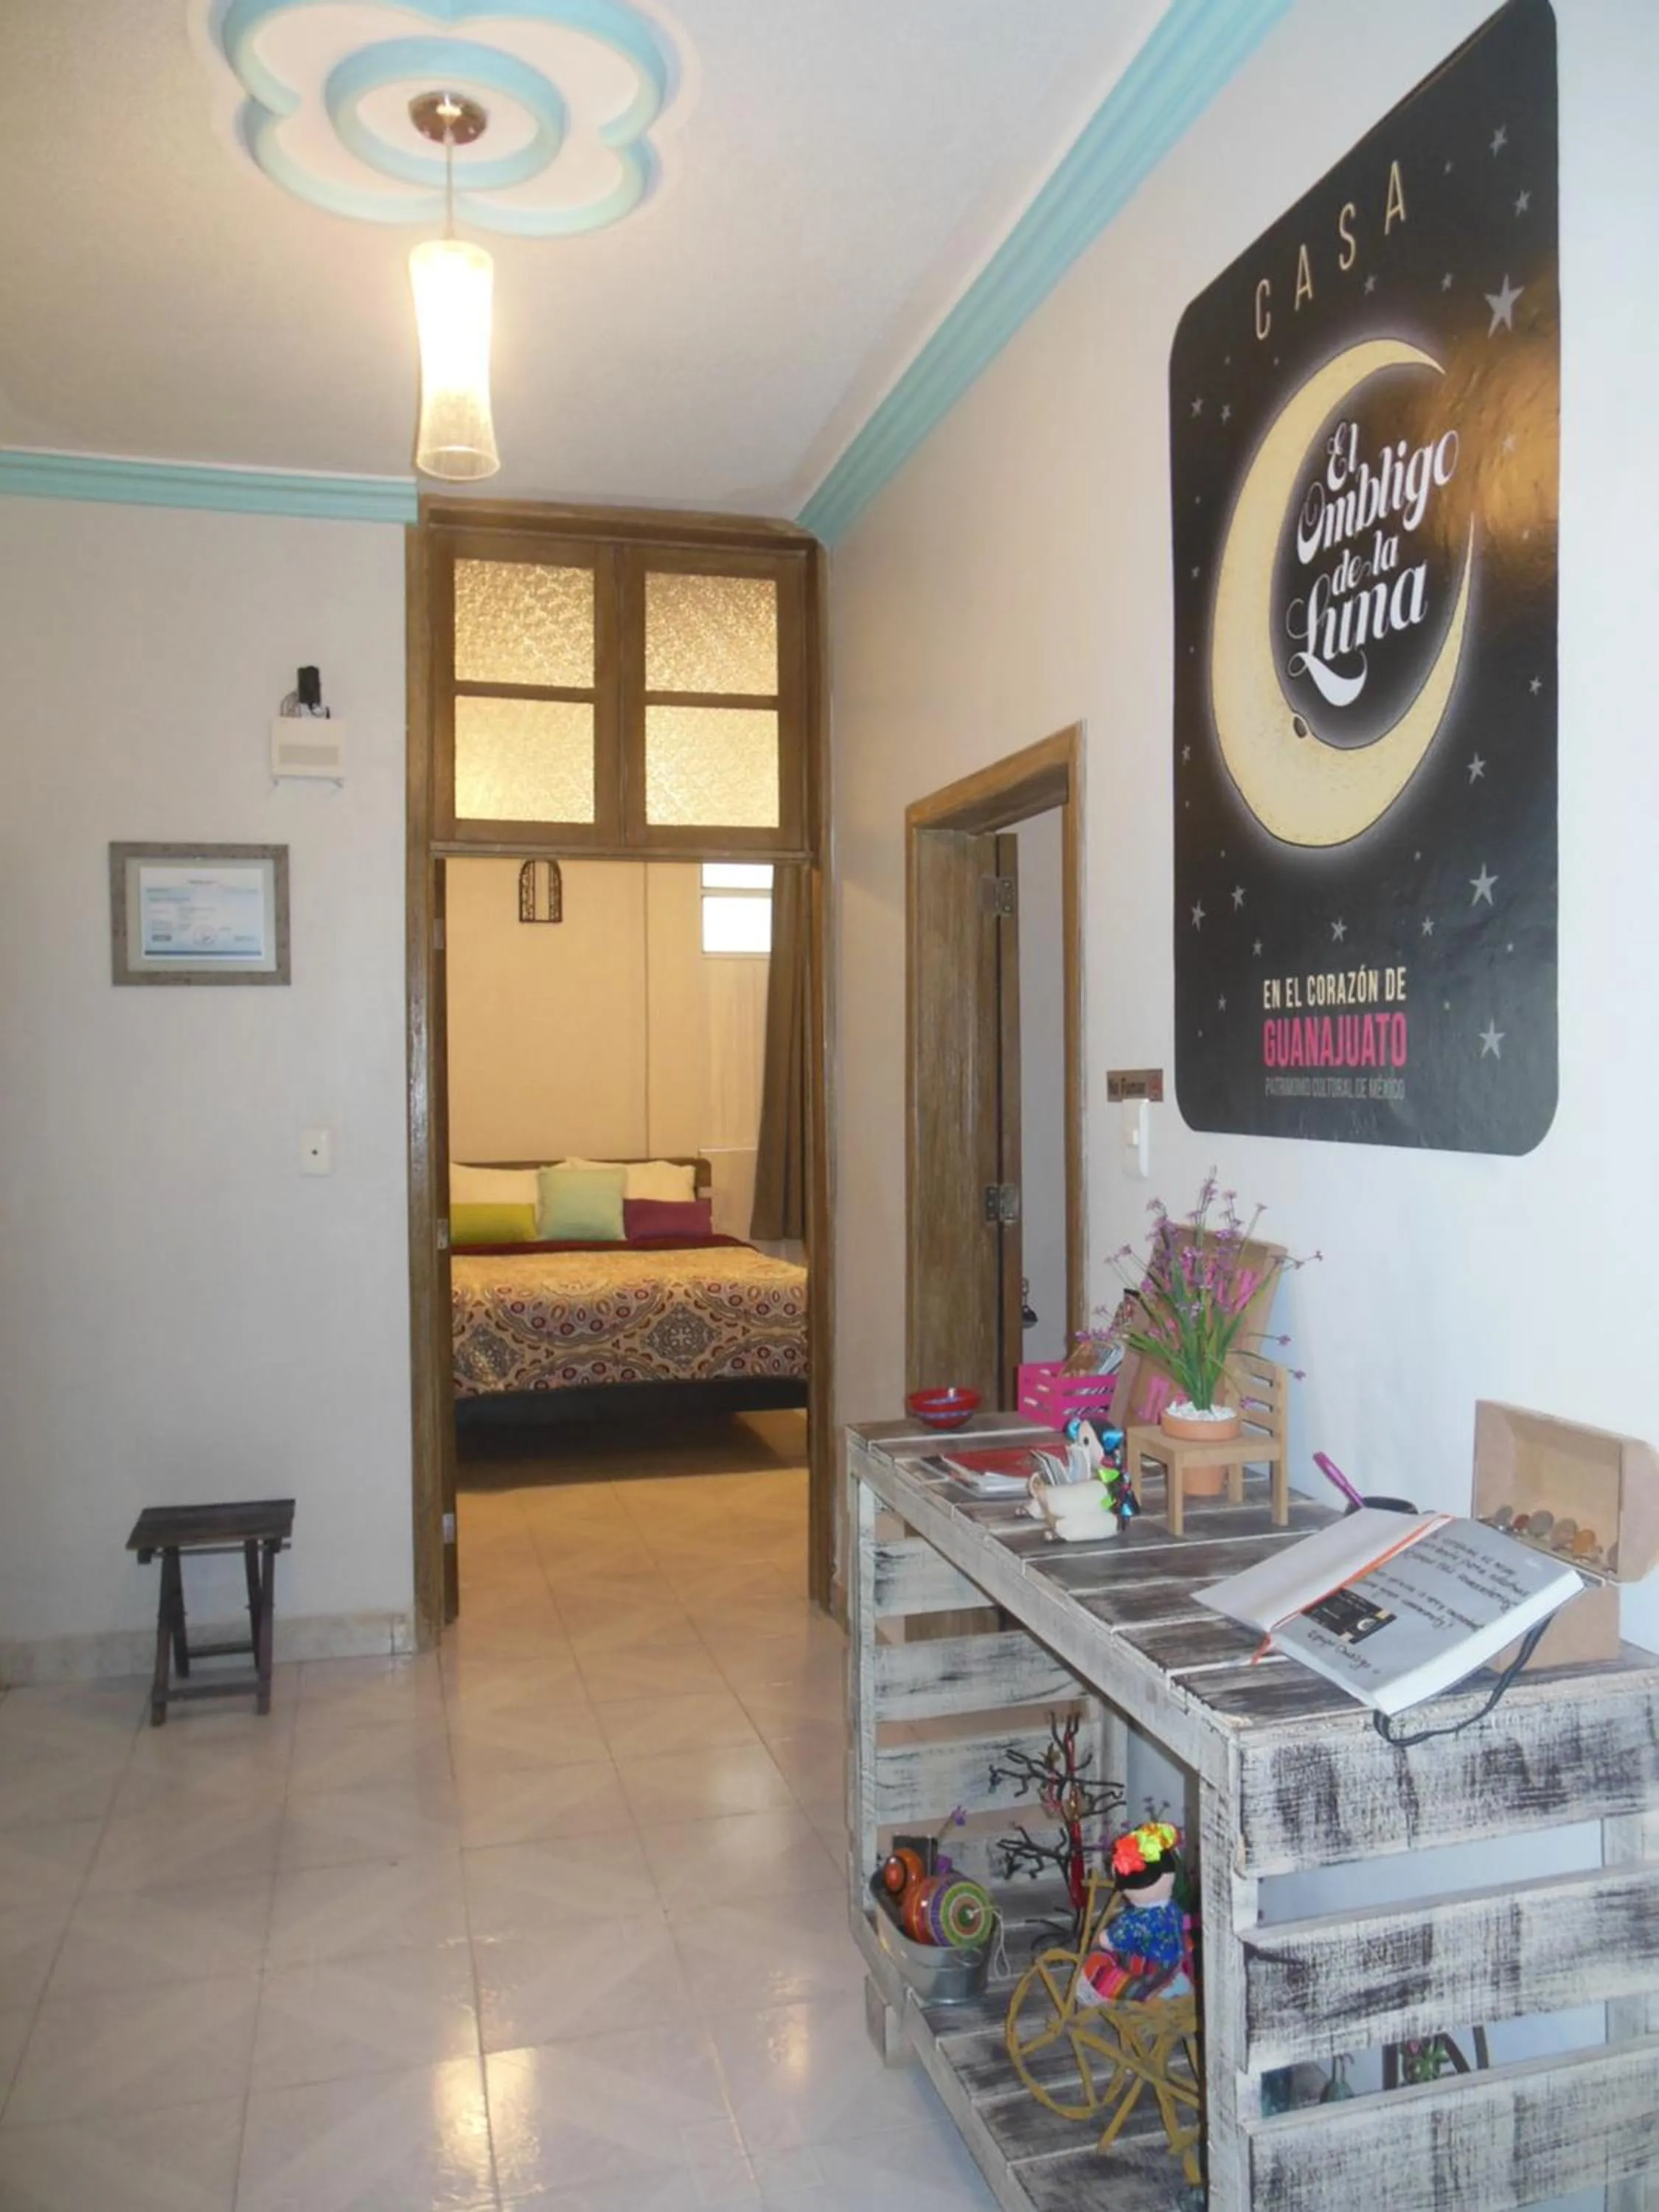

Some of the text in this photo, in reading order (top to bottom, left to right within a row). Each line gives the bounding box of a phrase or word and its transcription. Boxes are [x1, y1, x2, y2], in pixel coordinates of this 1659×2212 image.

[1255, 159, 1406, 341] CASA
[1328, 422, 1359, 493] El
[1297, 429, 1459, 564] Ombligo
[1332, 531, 1399, 597] de la
[1286, 561, 1429, 707] Luna
[1263, 964, 1407, 1009] EN EL CORAZÓN DE
[1263, 1012, 1408, 1068] GUANAJUATO
